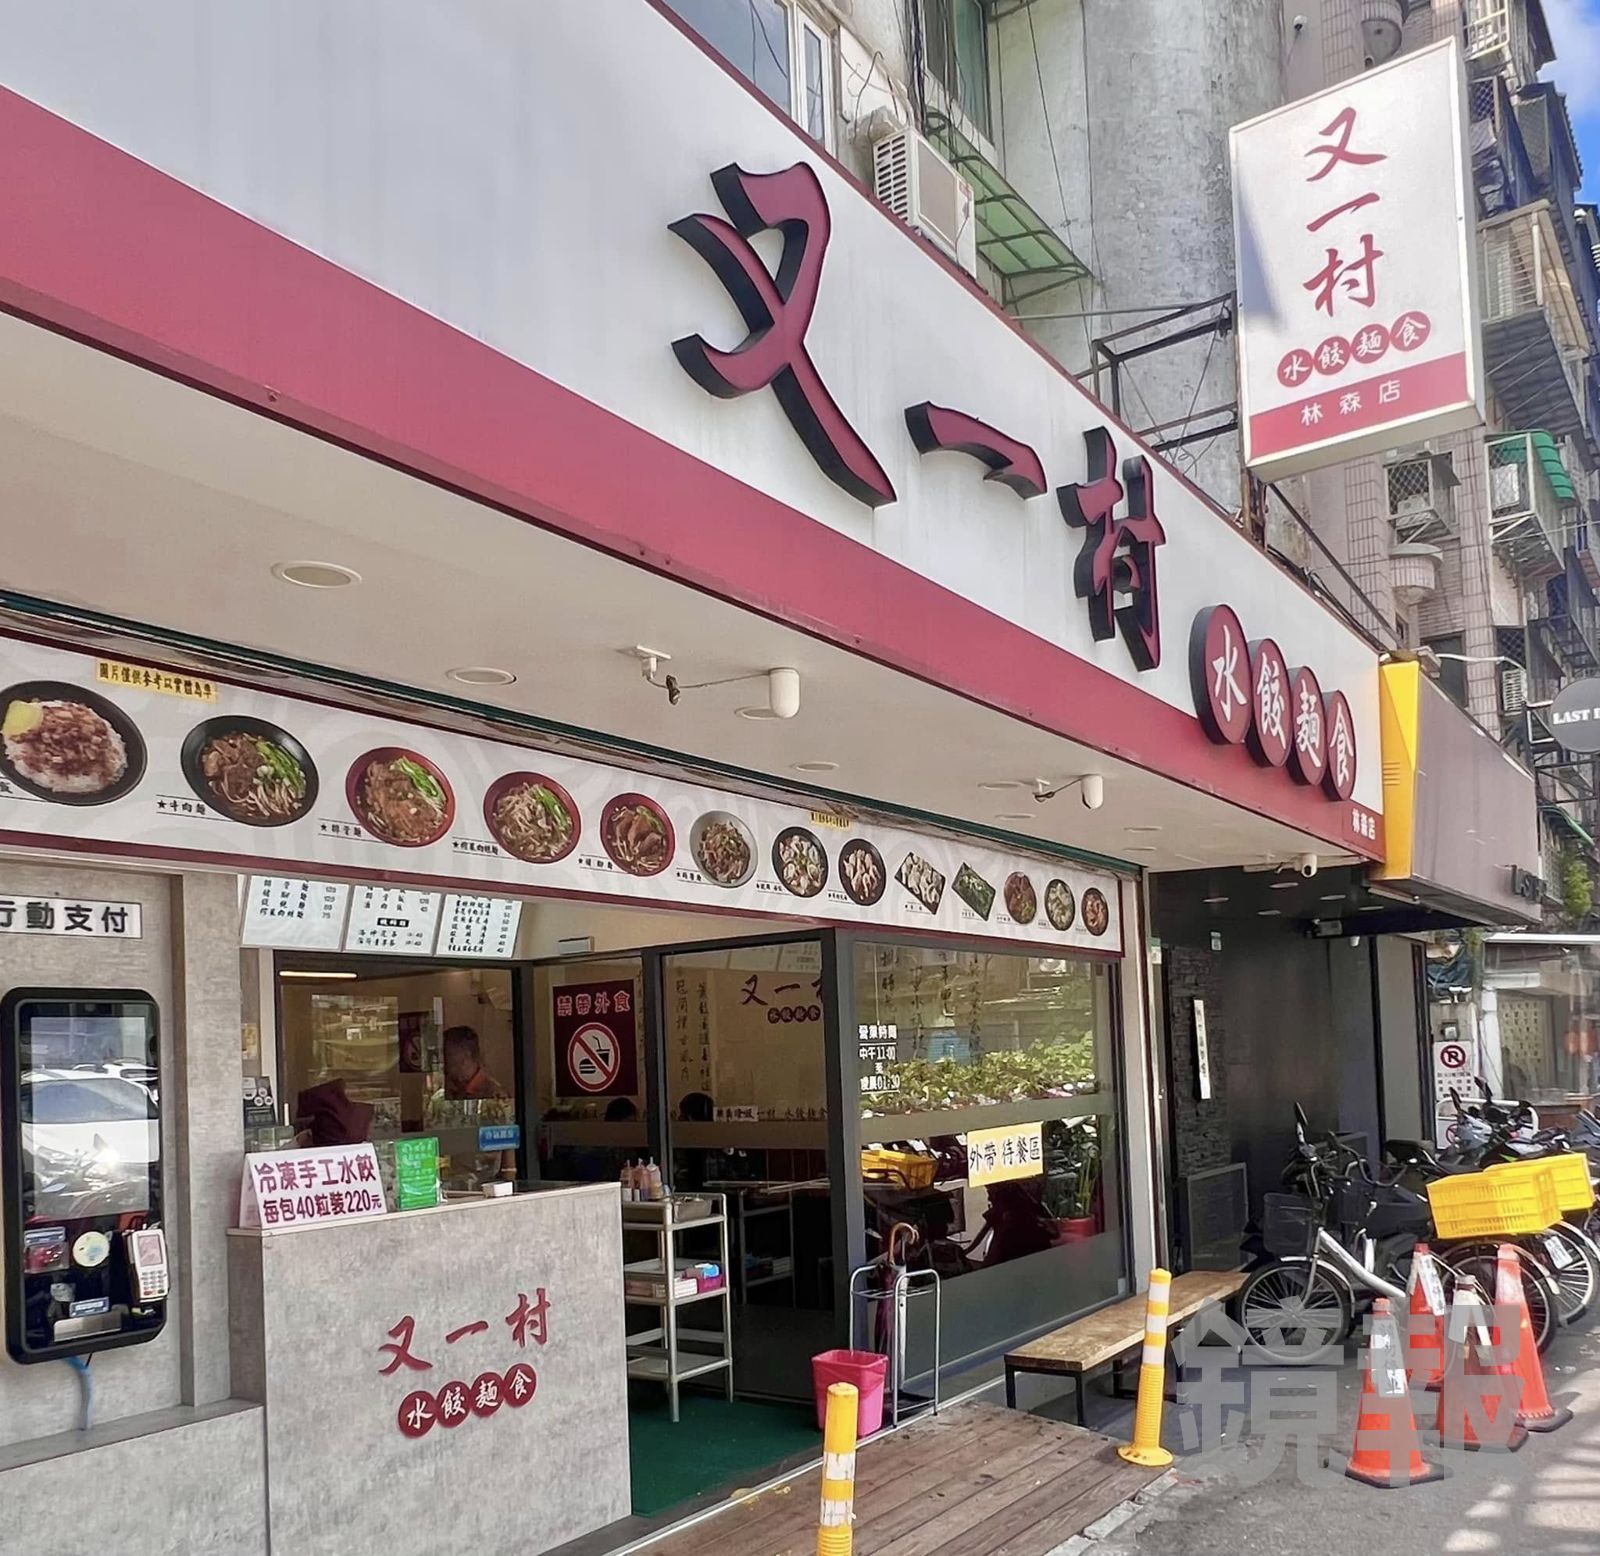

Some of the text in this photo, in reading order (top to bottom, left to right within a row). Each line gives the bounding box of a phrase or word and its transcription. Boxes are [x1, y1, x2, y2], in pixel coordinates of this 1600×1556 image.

[1304, 106, 1388, 317] 又一村
[1282, 316, 1427, 382] 水餃麵食
[668, 160, 1165, 672] 又一村
[1301, 371, 1400, 426] 林森店
[1211, 624, 1354, 788] 水餃麵食
[1553, 709, 1590, 725] LAST
[741, 974, 822, 1006] 又一
[254, 1154, 377, 1194] 冷凍手工水餃
[263, 1189, 383, 1224] 每包40粒裝220元
[378, 1287, 551, 1376] 又一村
[404, 1368, 533, 1430] 水餃麵食
